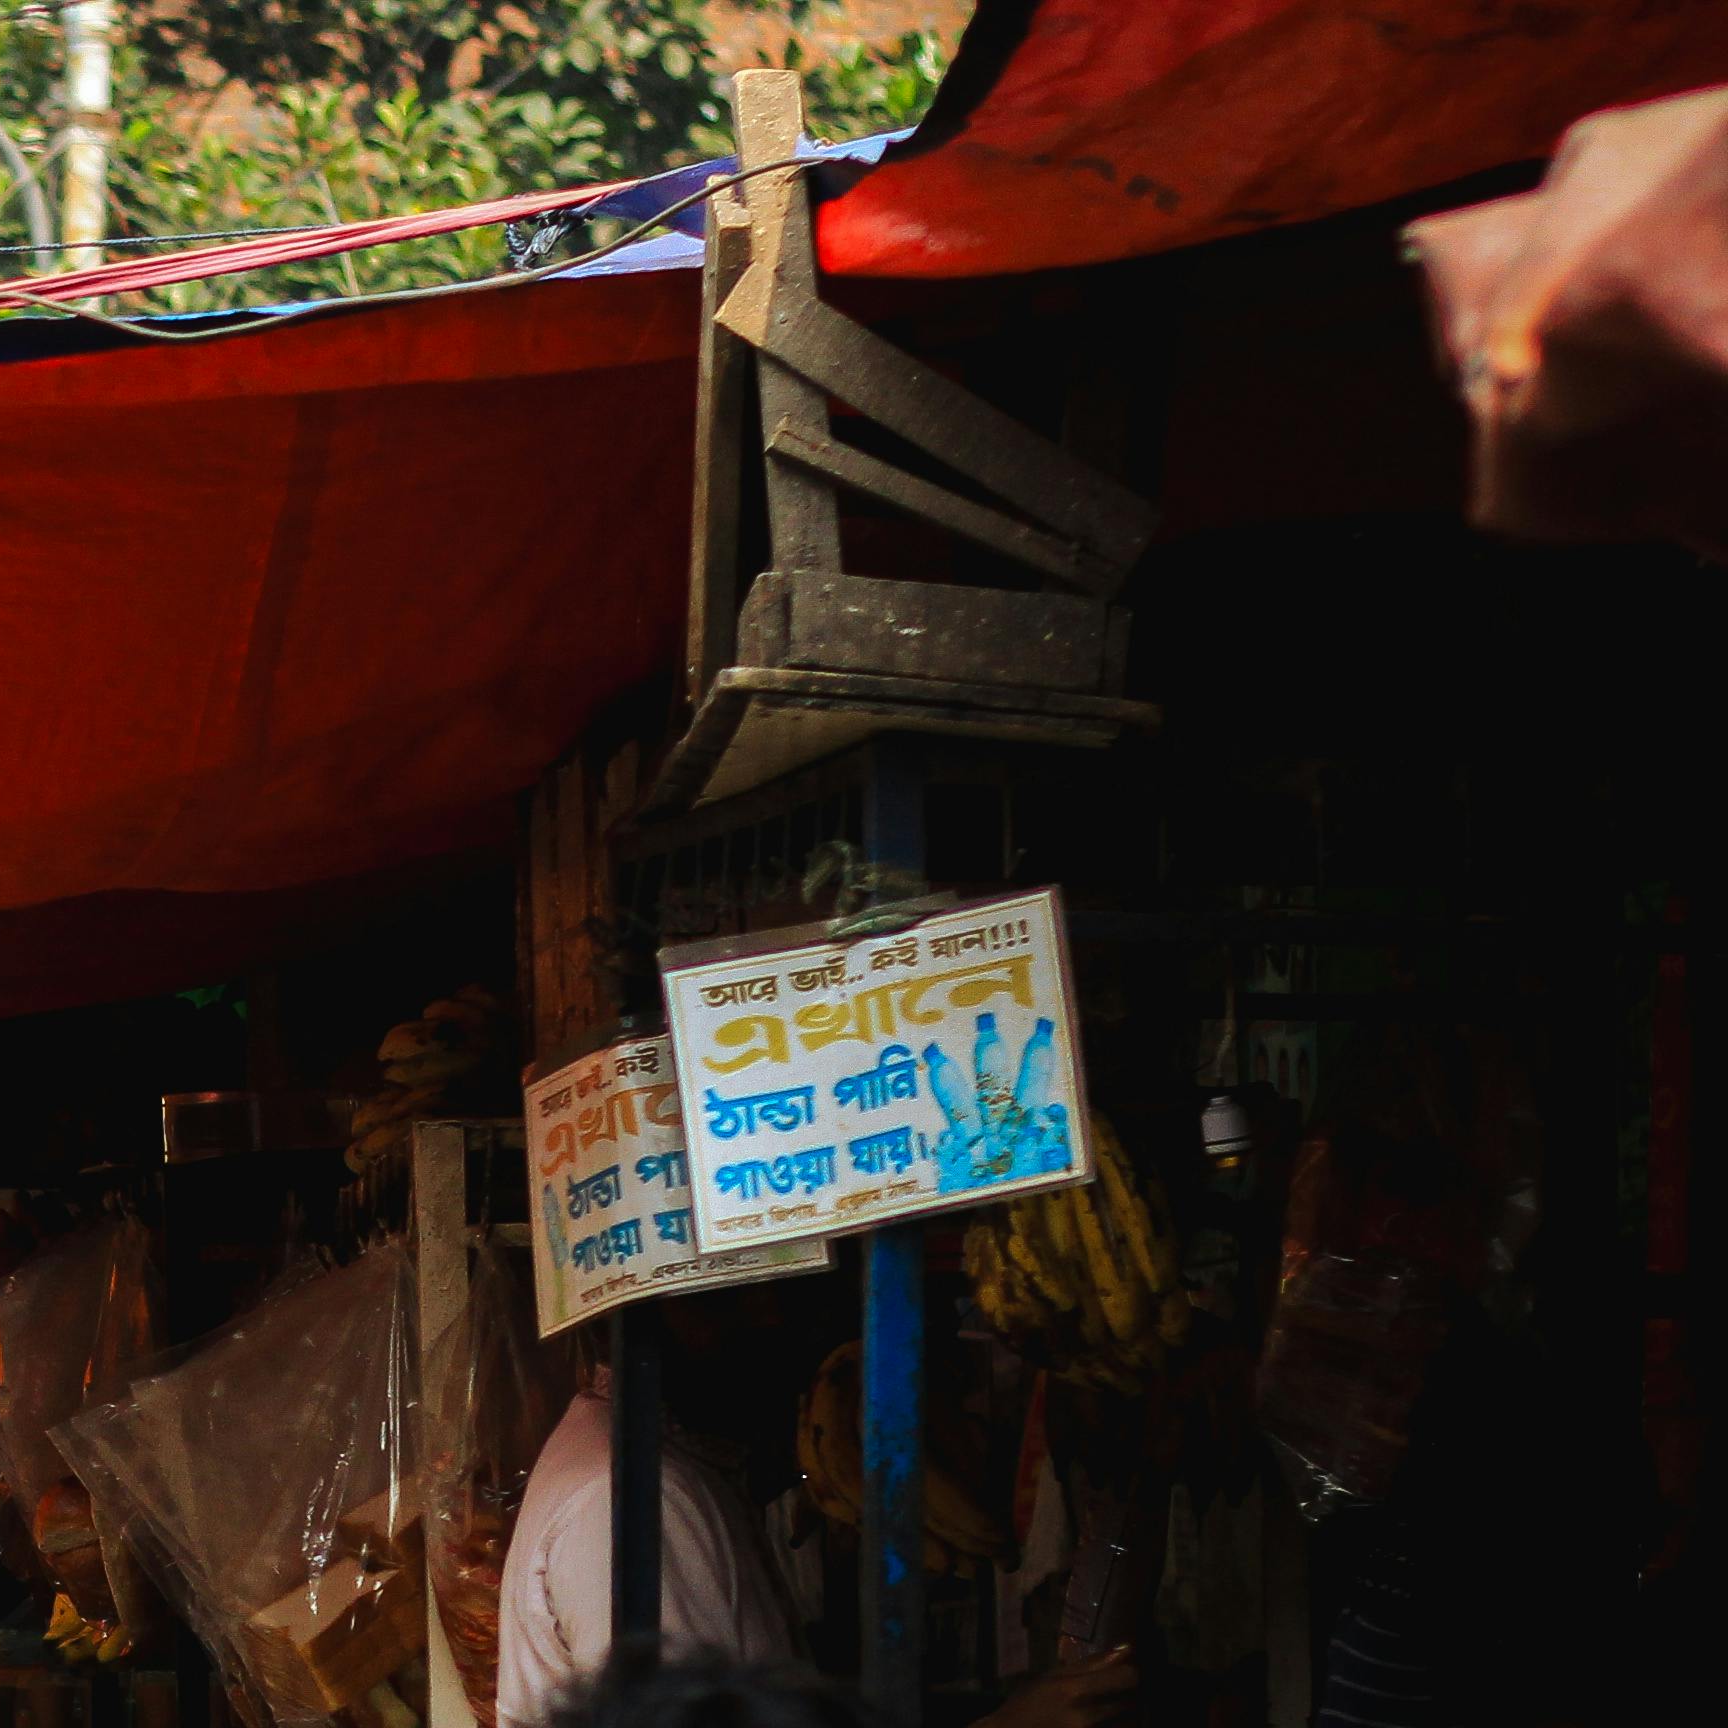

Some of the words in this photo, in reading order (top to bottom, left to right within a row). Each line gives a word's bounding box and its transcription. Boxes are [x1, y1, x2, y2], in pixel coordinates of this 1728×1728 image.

[701, 953, 1035, 1076] এখানে
[834, 1044, 918, 1113] পানি
[716, 1145, 835, 1201] পাওয়া
[572, 1217, 643, 1272] পাওয়া
